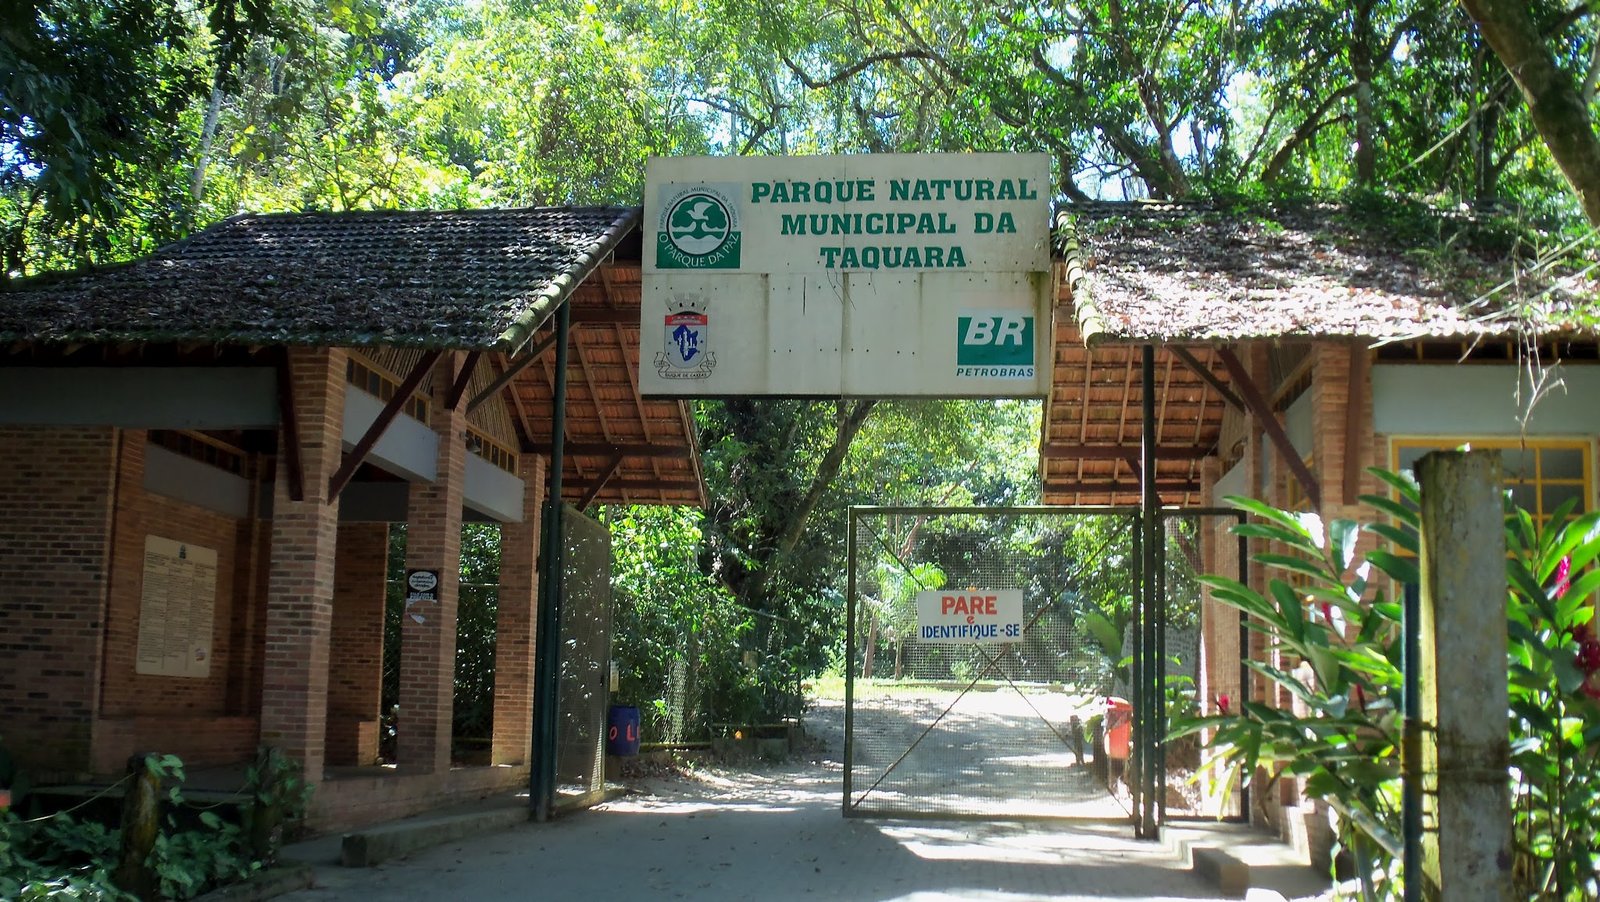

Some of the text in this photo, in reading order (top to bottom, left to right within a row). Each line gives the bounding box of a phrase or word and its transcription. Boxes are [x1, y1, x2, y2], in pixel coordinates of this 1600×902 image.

[691, 187, 722, 198] MUNICIPAL
[751, 178, 1038, 204] PARQUE NATURAL
[780, 212, 1017, 236] MUNICIPAL DA
[659, 233, 739, 268] O PARQUE DA PAZ
[820, 246, 967, 270] TAQUARA
[963, 316, 1026, 346] BR
[956, 368, 1034, 378] PETROBRAS
[942, 596, 997, 615] PARE
[966, 615, 975, 624] e
[922, 624, 1020, 640] IDENTIFIQUE-SE
